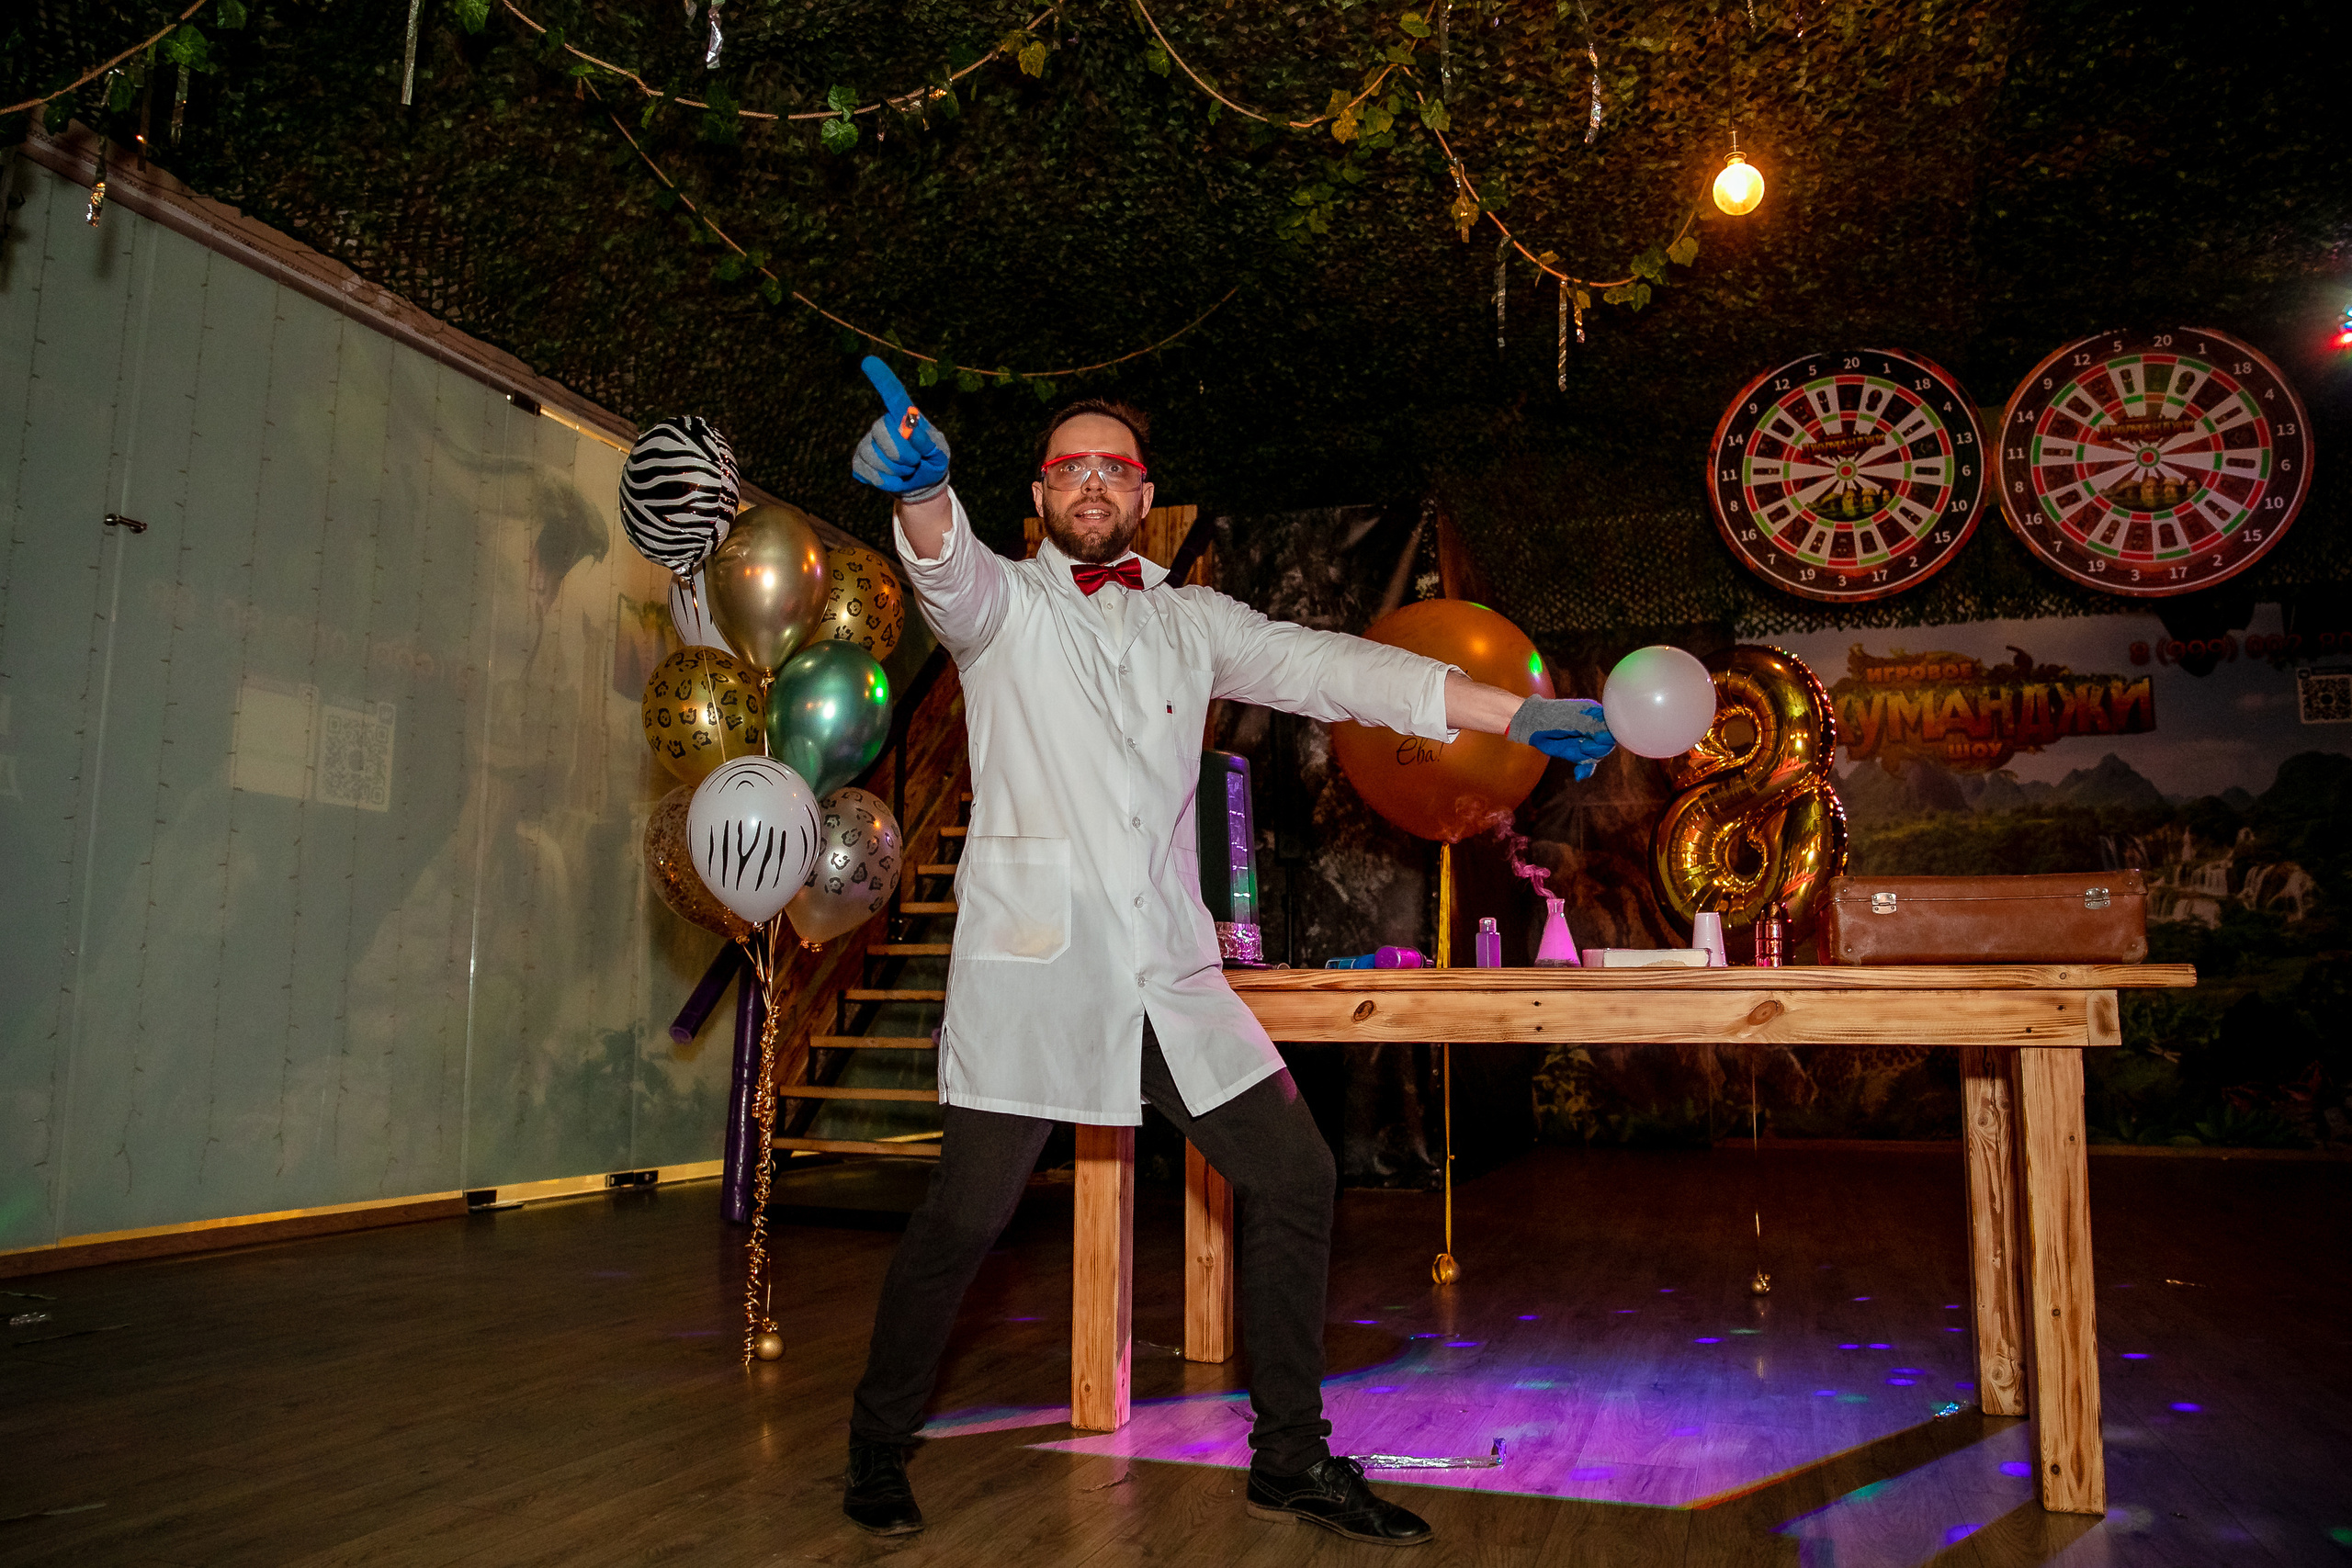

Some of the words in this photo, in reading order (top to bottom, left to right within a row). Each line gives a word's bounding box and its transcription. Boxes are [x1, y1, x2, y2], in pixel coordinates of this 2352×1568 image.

[2114, 341, 2122, 352] 5
[2154, 335, 2172, 347] 20
[2199, 344, 2206, 354] 1
[1844, 357, 1860, 369] 20
[2075, 354, 2090, 366] 12
[1809, 366, 1816, 376] 5
[1884, 363, 1890, 373] 1
[2234, 362, 2252, 374] 18
[1775, 378, 1790, 390] 12
[1916, 378, 1930, 390] 18
[2044, 378, 2052, 389] 9
[2265, 389, 2274, 400] 4
[1749, 403, 1758, 413] 9
[1944, 401, 1951, 412] 4
[2018, 411, 2034, 423] 14
[2278, 423, 2295, 435] 13
[1729, 434, 1743, 446] 14
[1957, 433, 1973, 445] 13
[2008, 448, 2024, 459] 11
[1962, 465, 1971, 476] 6
[2281, 459, 2290, 470] 6
[1723, 469, 1736, 481] 11
[2015, 481, 2023, 492] 8
[1731, 501, 1738, 512] 8
[1952, 500, 1967, 512] 10
[2266, 497, 2283, 509] 10
[2026, 513, 2042, 525] 16
[1742, 529, 1757, 541] 16
[1935, 531, 1951, 543] 15
[2244, 529, 2262, 542] 15
[2054, 541, 2062, 552] 7
[1768, 554, 1775, 564] 7
[1910, 556, 1917, 567] 2
[2088, 559, 2105, 571] 19
[2213, 554, 2222, 566] 2
[1801, 569, 1815, 581] 19
[1873, 570, 1887, 581] 17
[2132, 570, 2140, 581] 3
[2170, 567, 2187, 579] 17
[1839, 575, 1846, 586] 3
[2130, 642, 2150, 666] 8
[1866, 663, 1973, 682] ИГРОВОЕ
[1835, 676, 2155, 761] УМАНДЖИ
[1948, 743, 2003, 759] ШОУ
